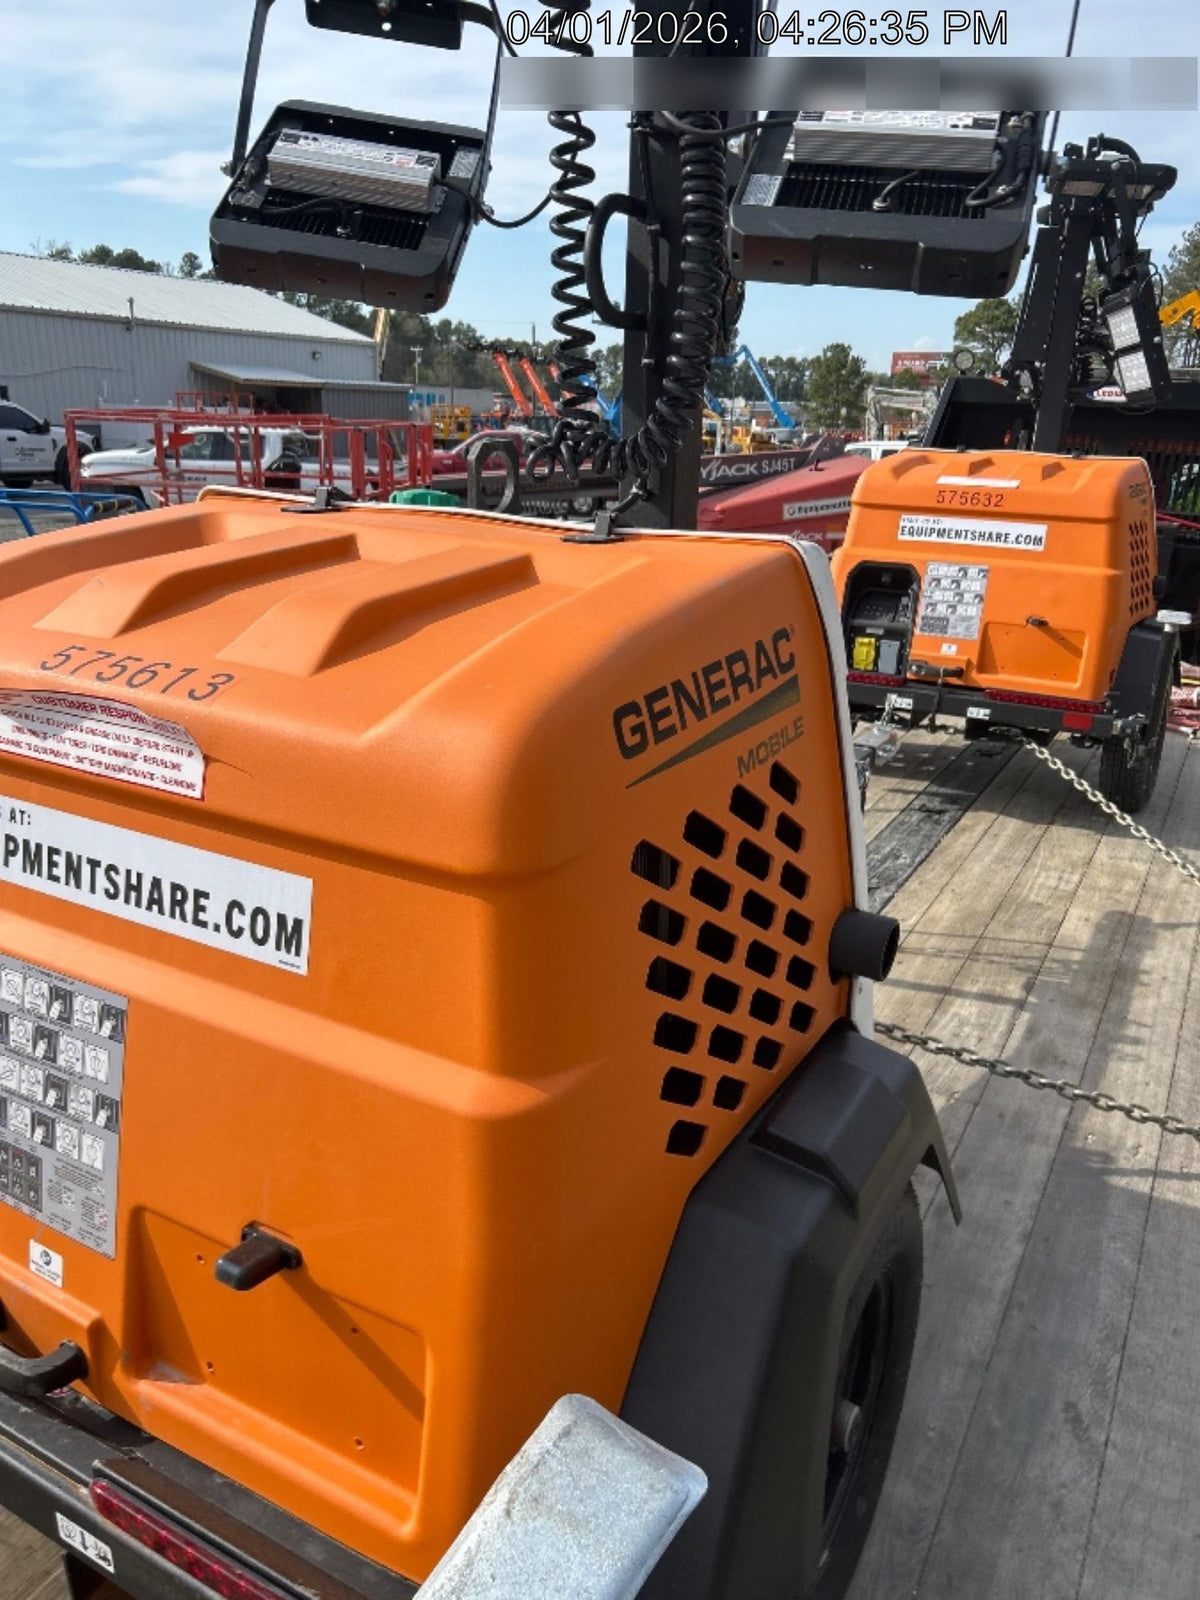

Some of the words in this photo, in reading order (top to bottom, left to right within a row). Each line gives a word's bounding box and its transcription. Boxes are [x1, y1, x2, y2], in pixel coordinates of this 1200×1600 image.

[700, 459, 760, 481] YJACK
[761, 457, 796, 474] SJ45T
[936, 490, 1004, 507] 575632
[900, 525, 1043, 546] EQUIPMENTSHARE.COM
[40, 645, 235, 701] 575613
[613, 627, 796, 760] GENERAC
[736, 716, 804, 778] MOBILE
[9, 806, 31, 826] AT:
[3, 833, 304, 958] PMENTSHARE.COM
